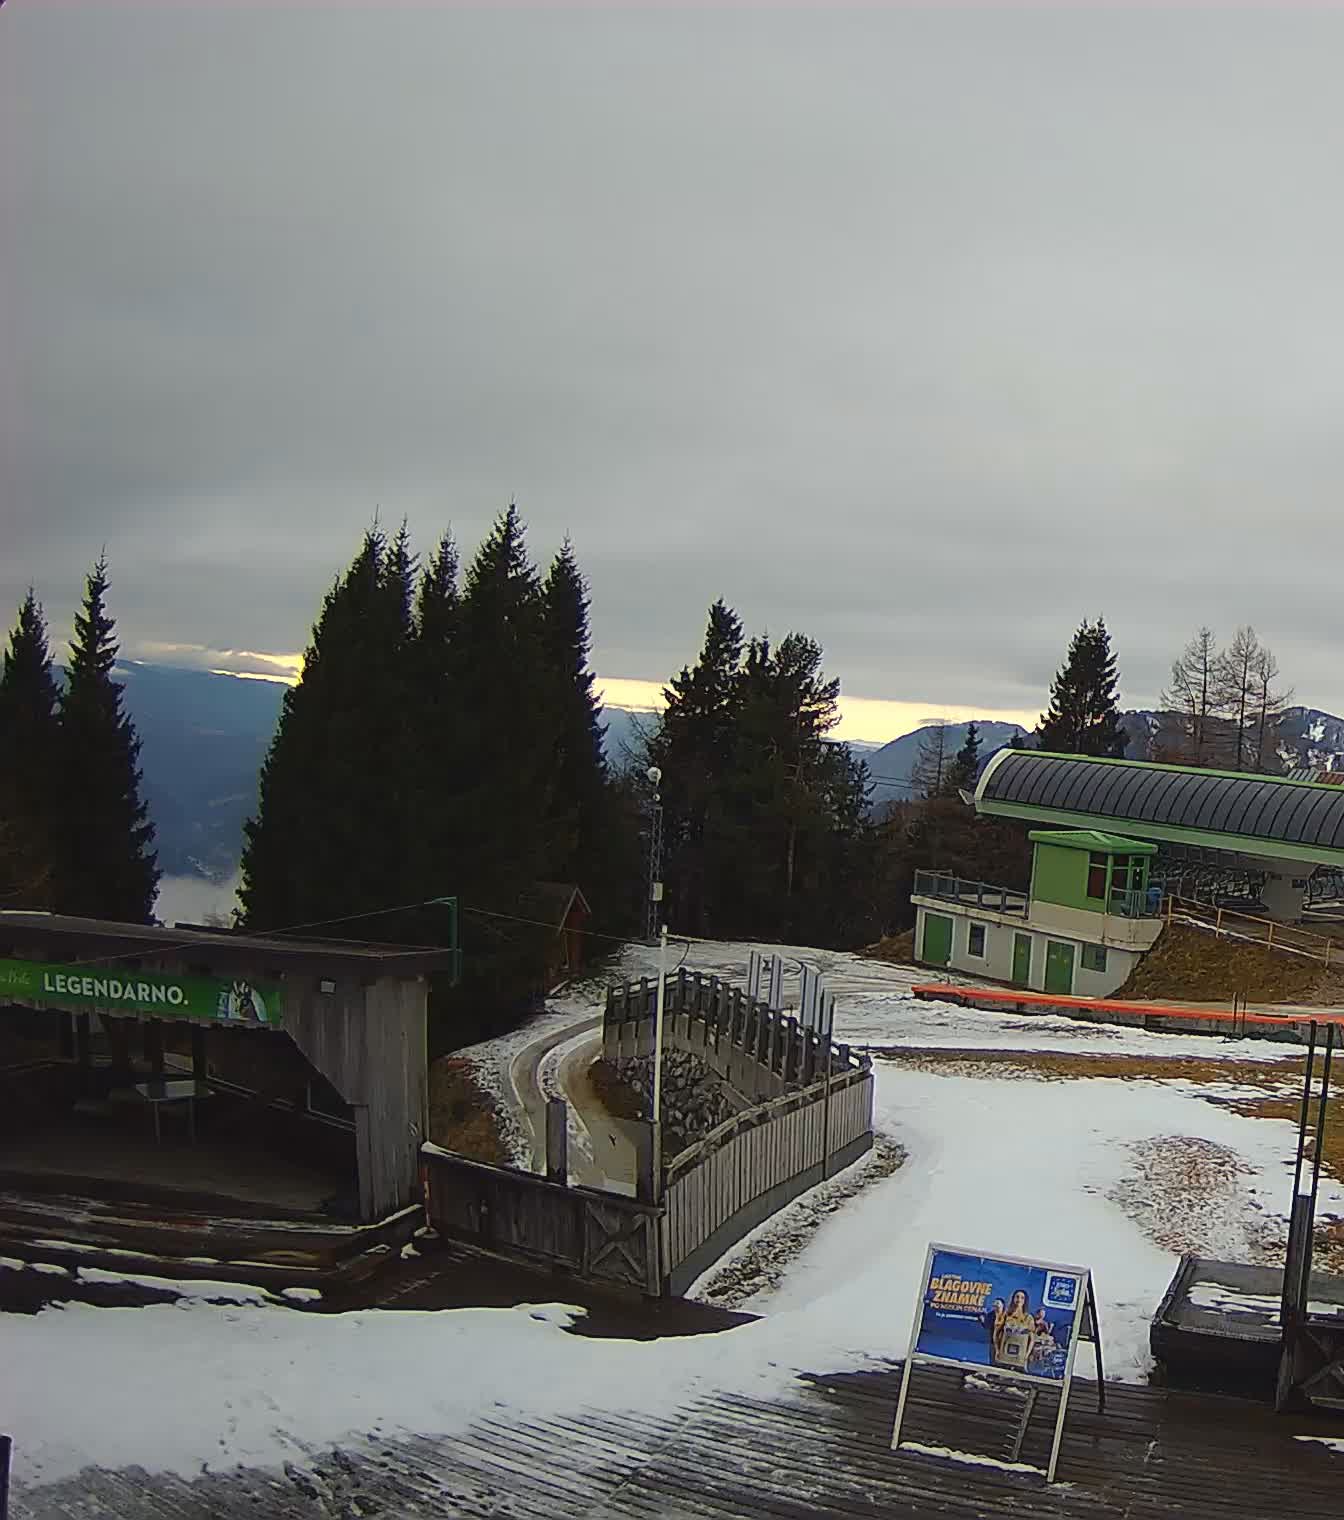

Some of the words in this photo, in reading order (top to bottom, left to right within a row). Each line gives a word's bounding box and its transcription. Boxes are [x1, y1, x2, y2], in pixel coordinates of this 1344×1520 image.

[44, 973, 189, 1005] LEGENDARNO.
[930, 1277, 992, 1296] BLAGOVNE
[933, 1290, 985, 1306] ZNAMKE
